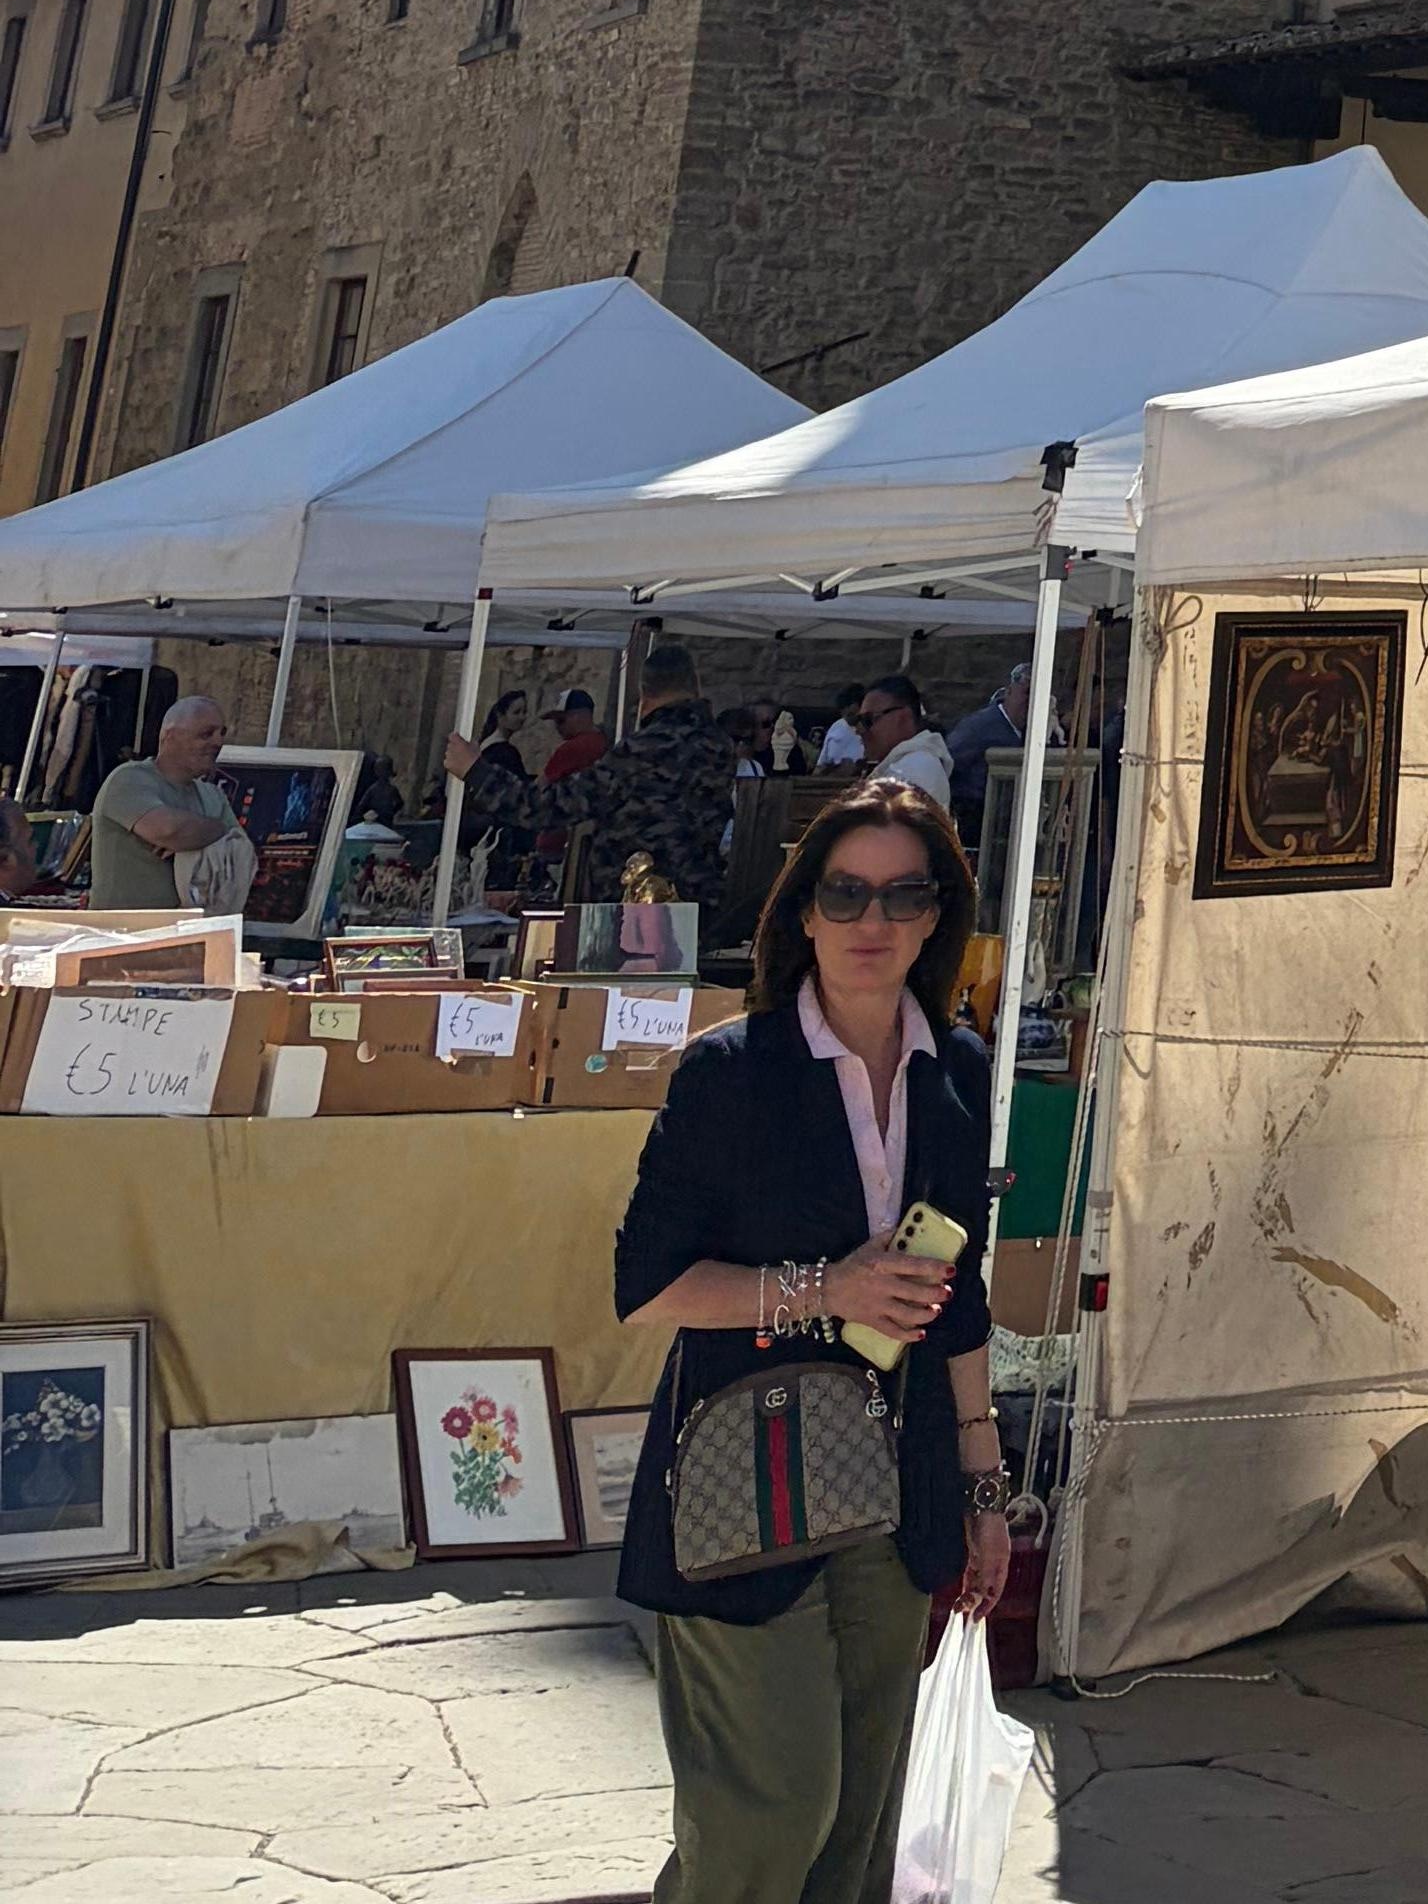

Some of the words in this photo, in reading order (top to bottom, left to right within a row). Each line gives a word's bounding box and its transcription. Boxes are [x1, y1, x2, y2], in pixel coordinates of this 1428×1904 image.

[78, 998, 174, 1036] STAMPE
[449, 1001, 481, 1038] €5
[617, 998, 642, 1030] €5
[65, 1043, 117, 1095] €5
[127, 1069, 190, 1097] L'UNA
